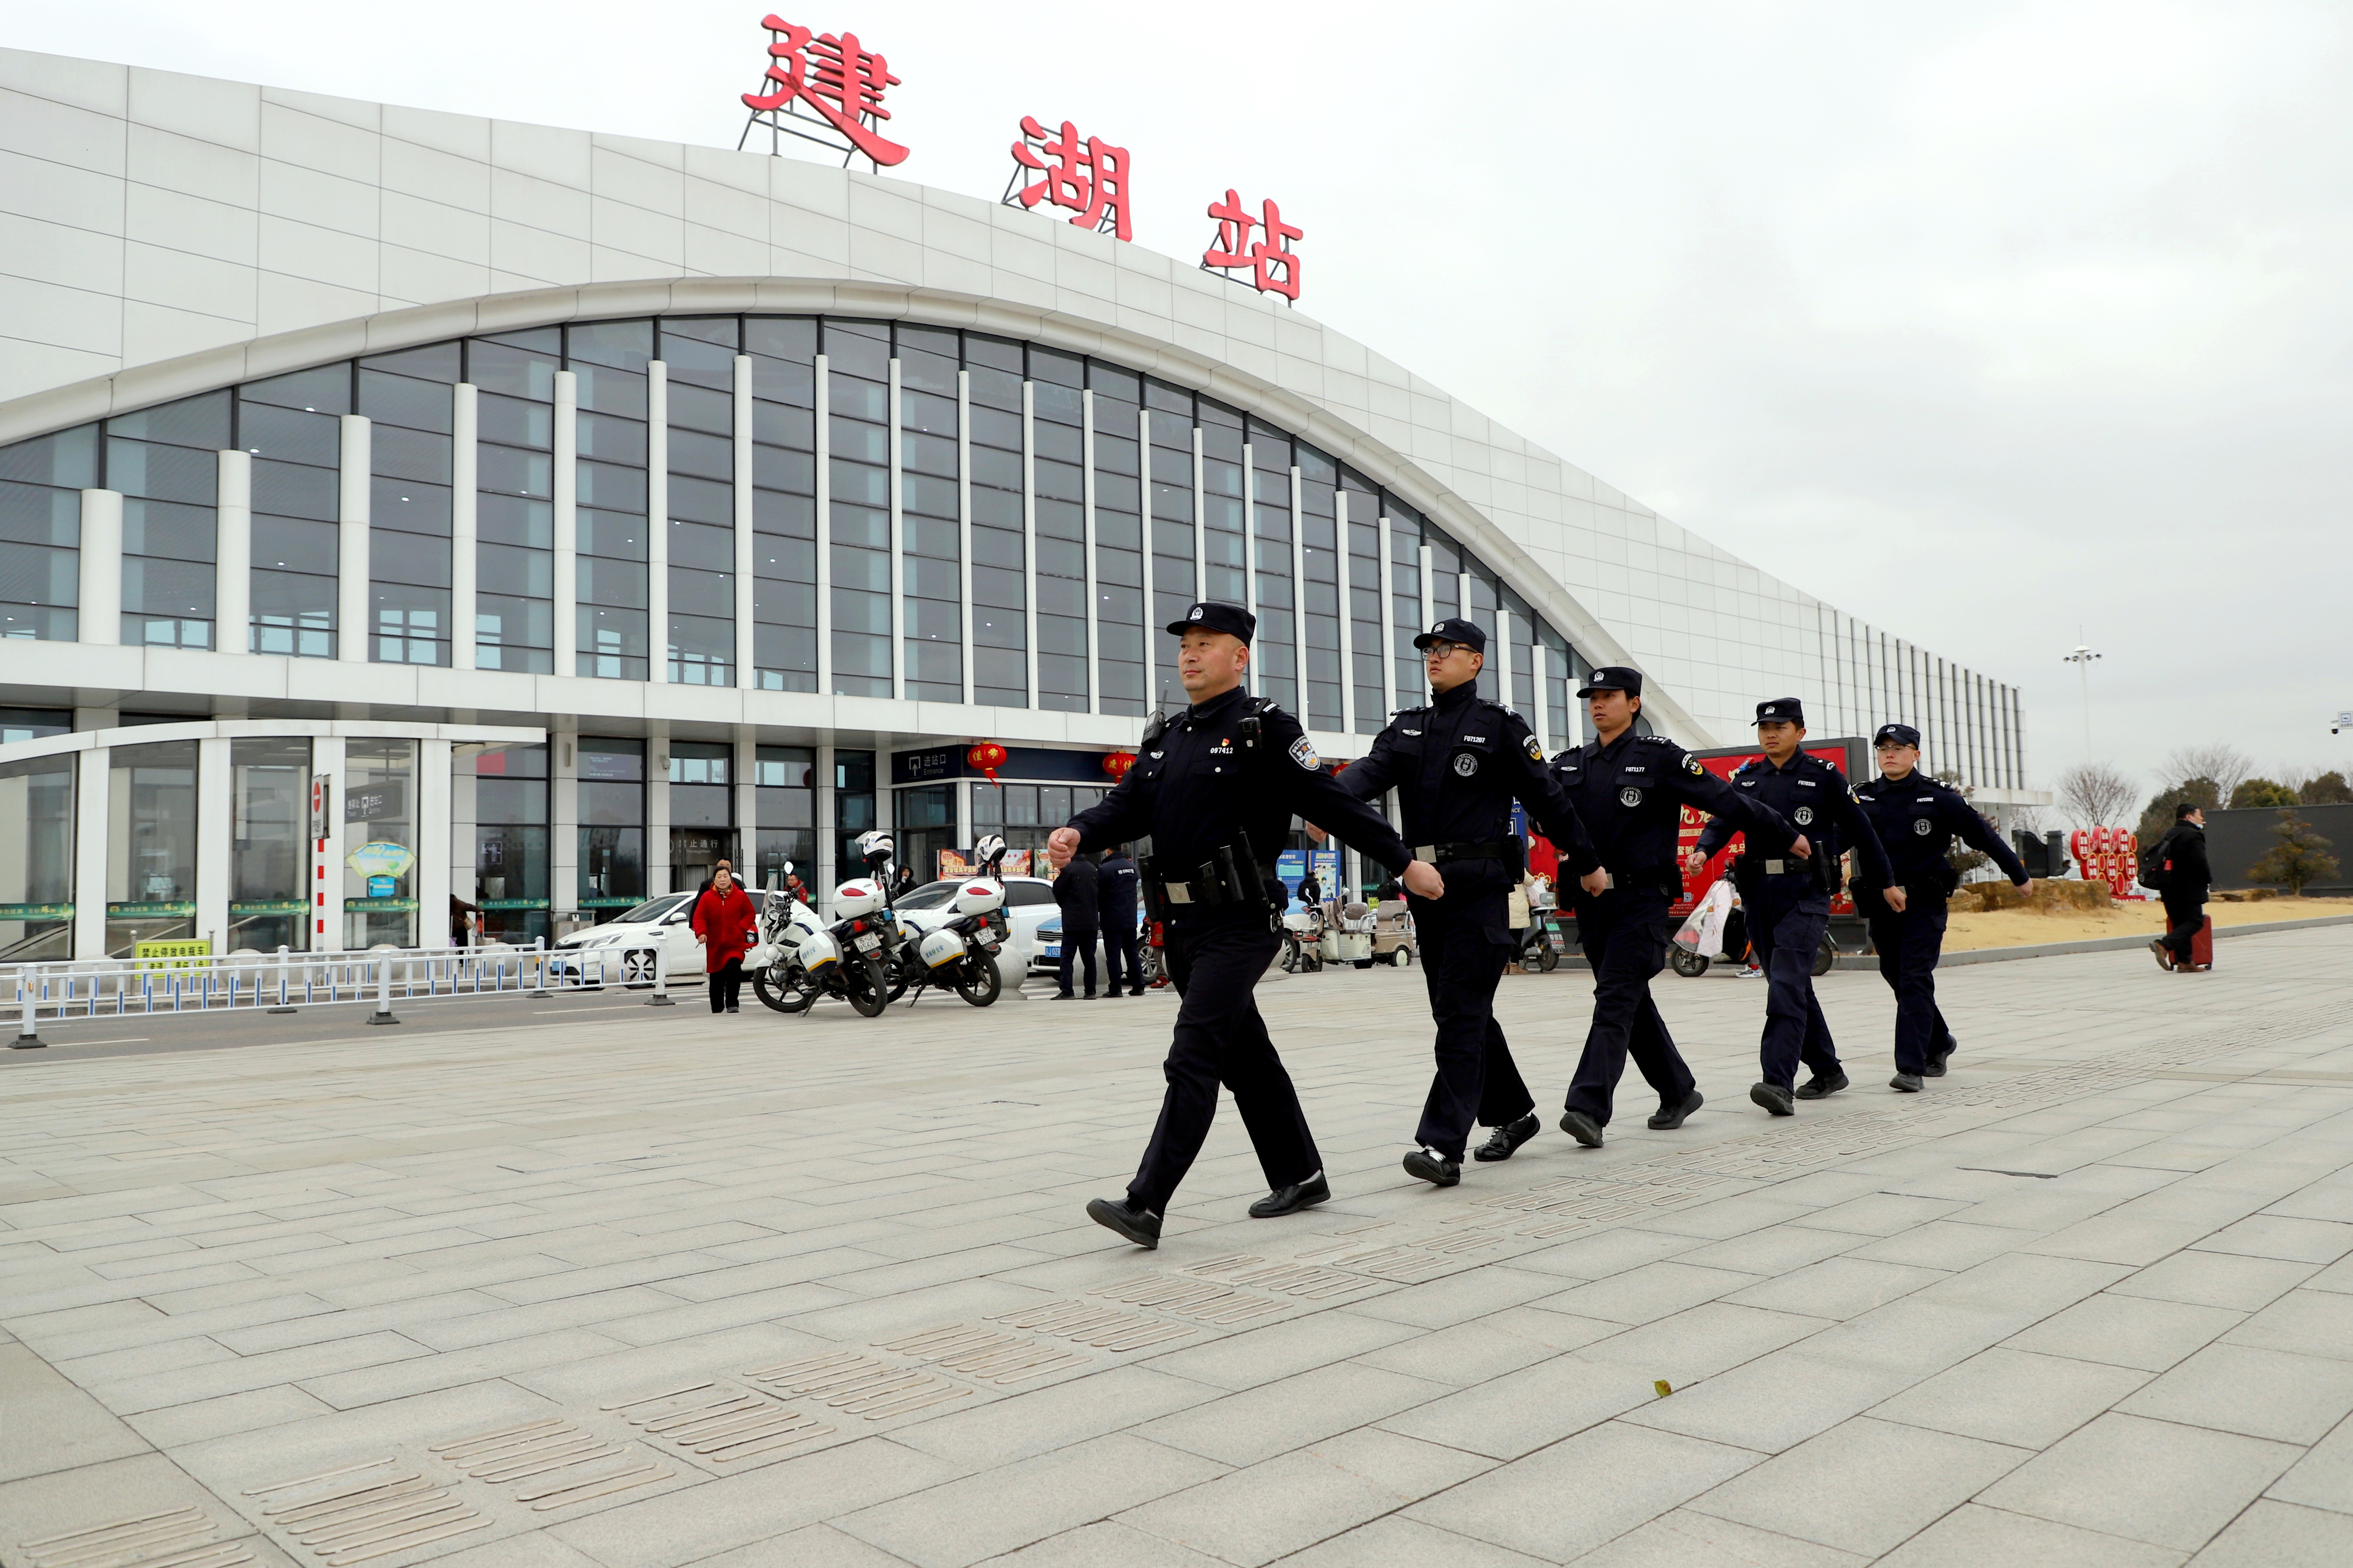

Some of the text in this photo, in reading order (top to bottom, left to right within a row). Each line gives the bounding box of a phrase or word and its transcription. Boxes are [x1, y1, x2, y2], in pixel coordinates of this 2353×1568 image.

[741, 14, 1303, 300] 建湖站
[1464, 735, 1485, 743] F071207
[923, 754, 946, 767] 进站口
[979, 934, 993, 945] 9570
[858, 941, 876, 952] 9566
